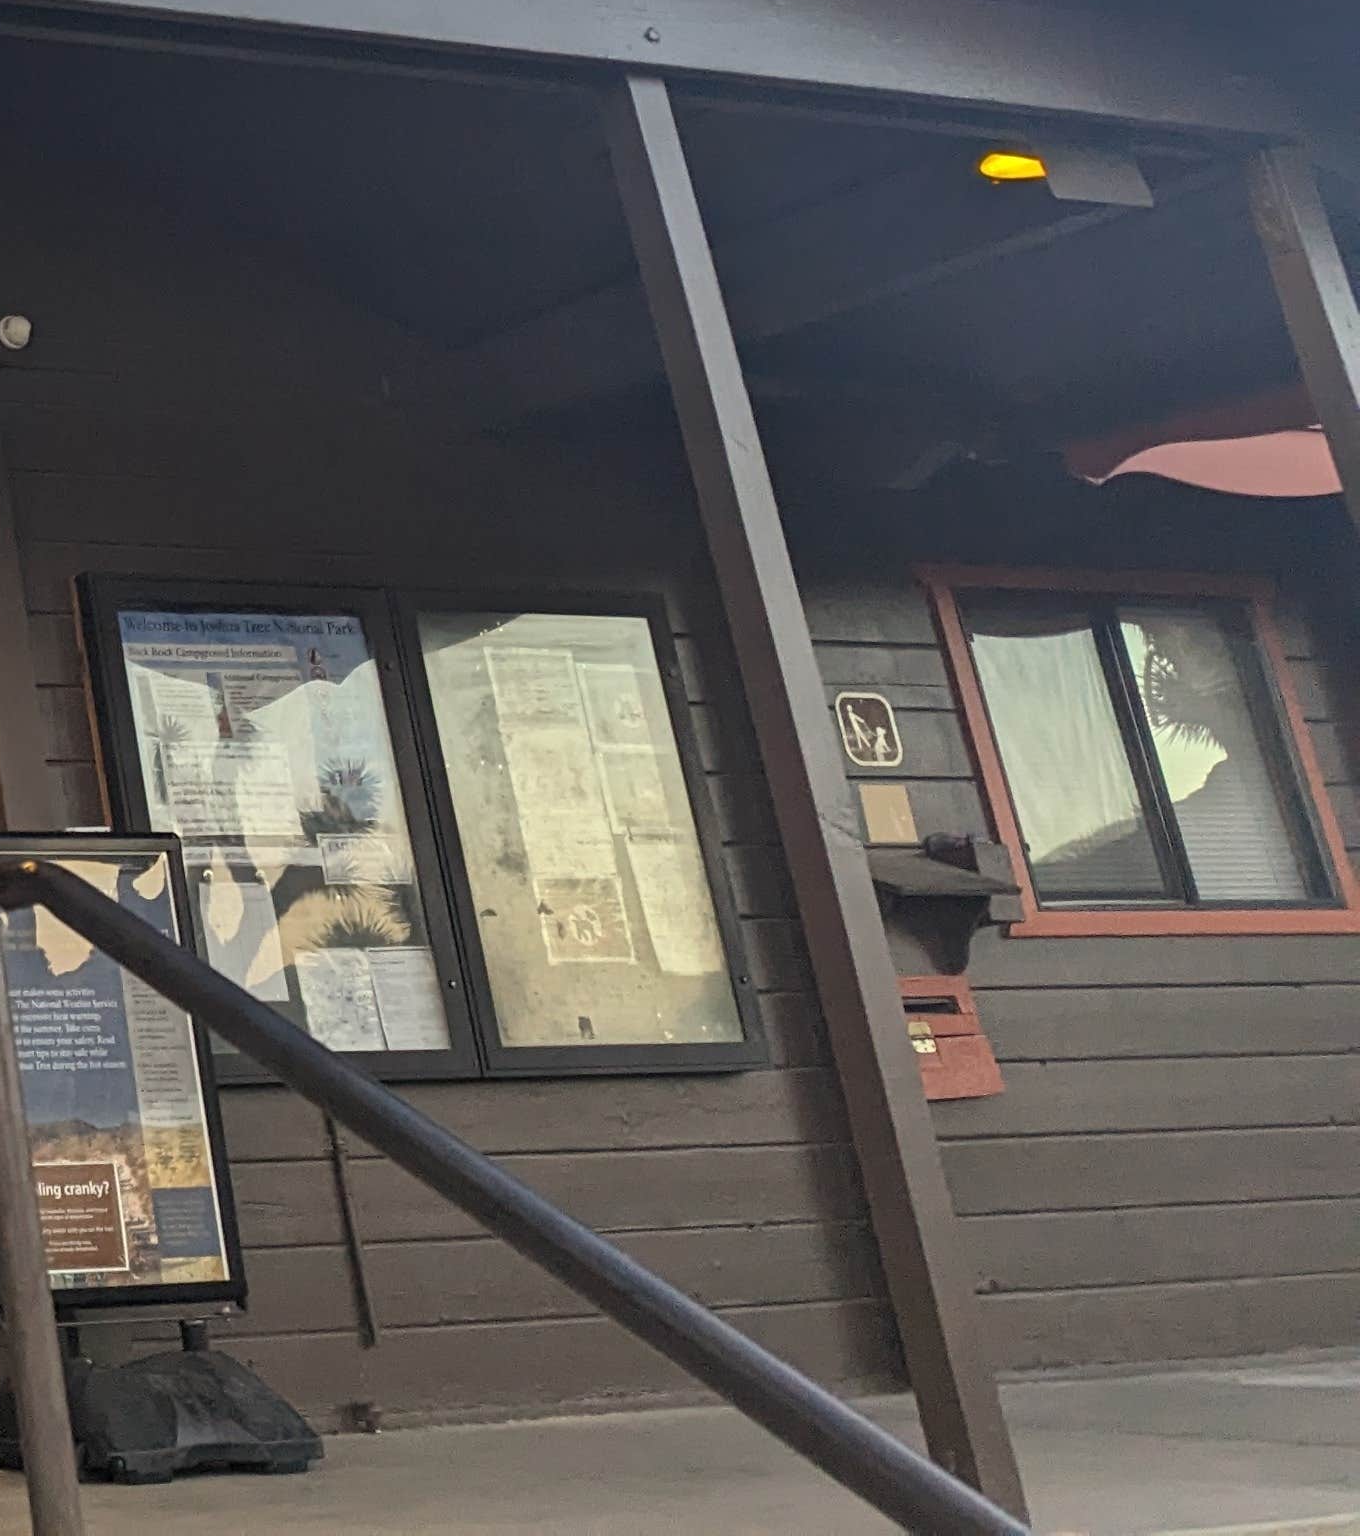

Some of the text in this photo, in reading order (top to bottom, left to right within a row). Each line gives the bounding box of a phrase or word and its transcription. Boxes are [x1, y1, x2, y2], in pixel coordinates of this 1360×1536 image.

[123, 616, 182, 632] Welcome
[242, 619, 271, 633] Tree
[326, 621, 353, 635] Park
[15, 1000, 30, 1008] The
[31, 999, 61, 1009] National
[92, 999, 118, 1008] Service
[37, 1181, 109, 1199] ling cranky?
